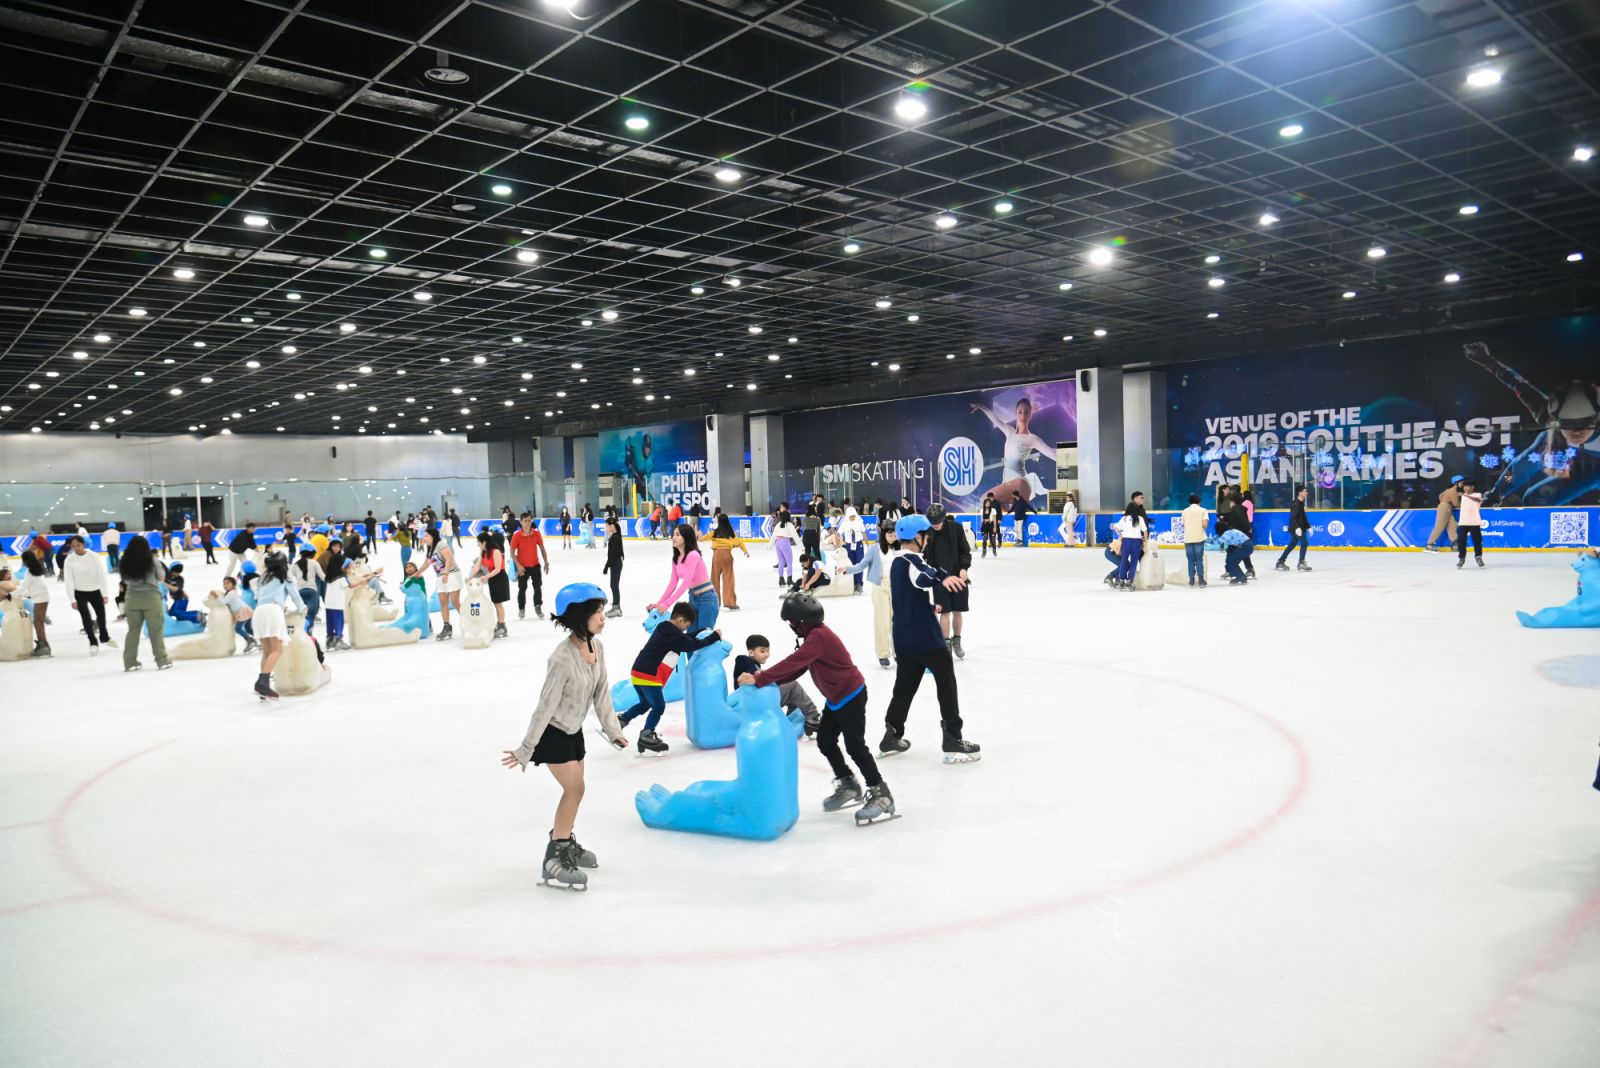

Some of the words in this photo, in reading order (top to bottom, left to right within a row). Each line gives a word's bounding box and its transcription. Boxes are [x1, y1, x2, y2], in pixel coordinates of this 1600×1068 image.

[1205, 413, 1277, 434] VENUE
[1280, 411, 1311, 429] OF
[1314, 406, 1361, 427] THE
[1204, 432, 1279, 460] 2019
[1285, 415, 1521, 457] SOUTHEAST
[676, 460, 705, 473] HOME
[1204, 457, 1304, 487] ASIAN
[1310, 450, 1444, 488] GAMES
[661, 473, 708, 492] PHILIP
[682, 491, 710, 511] SPO
[470, 608, 480, 616] 08
